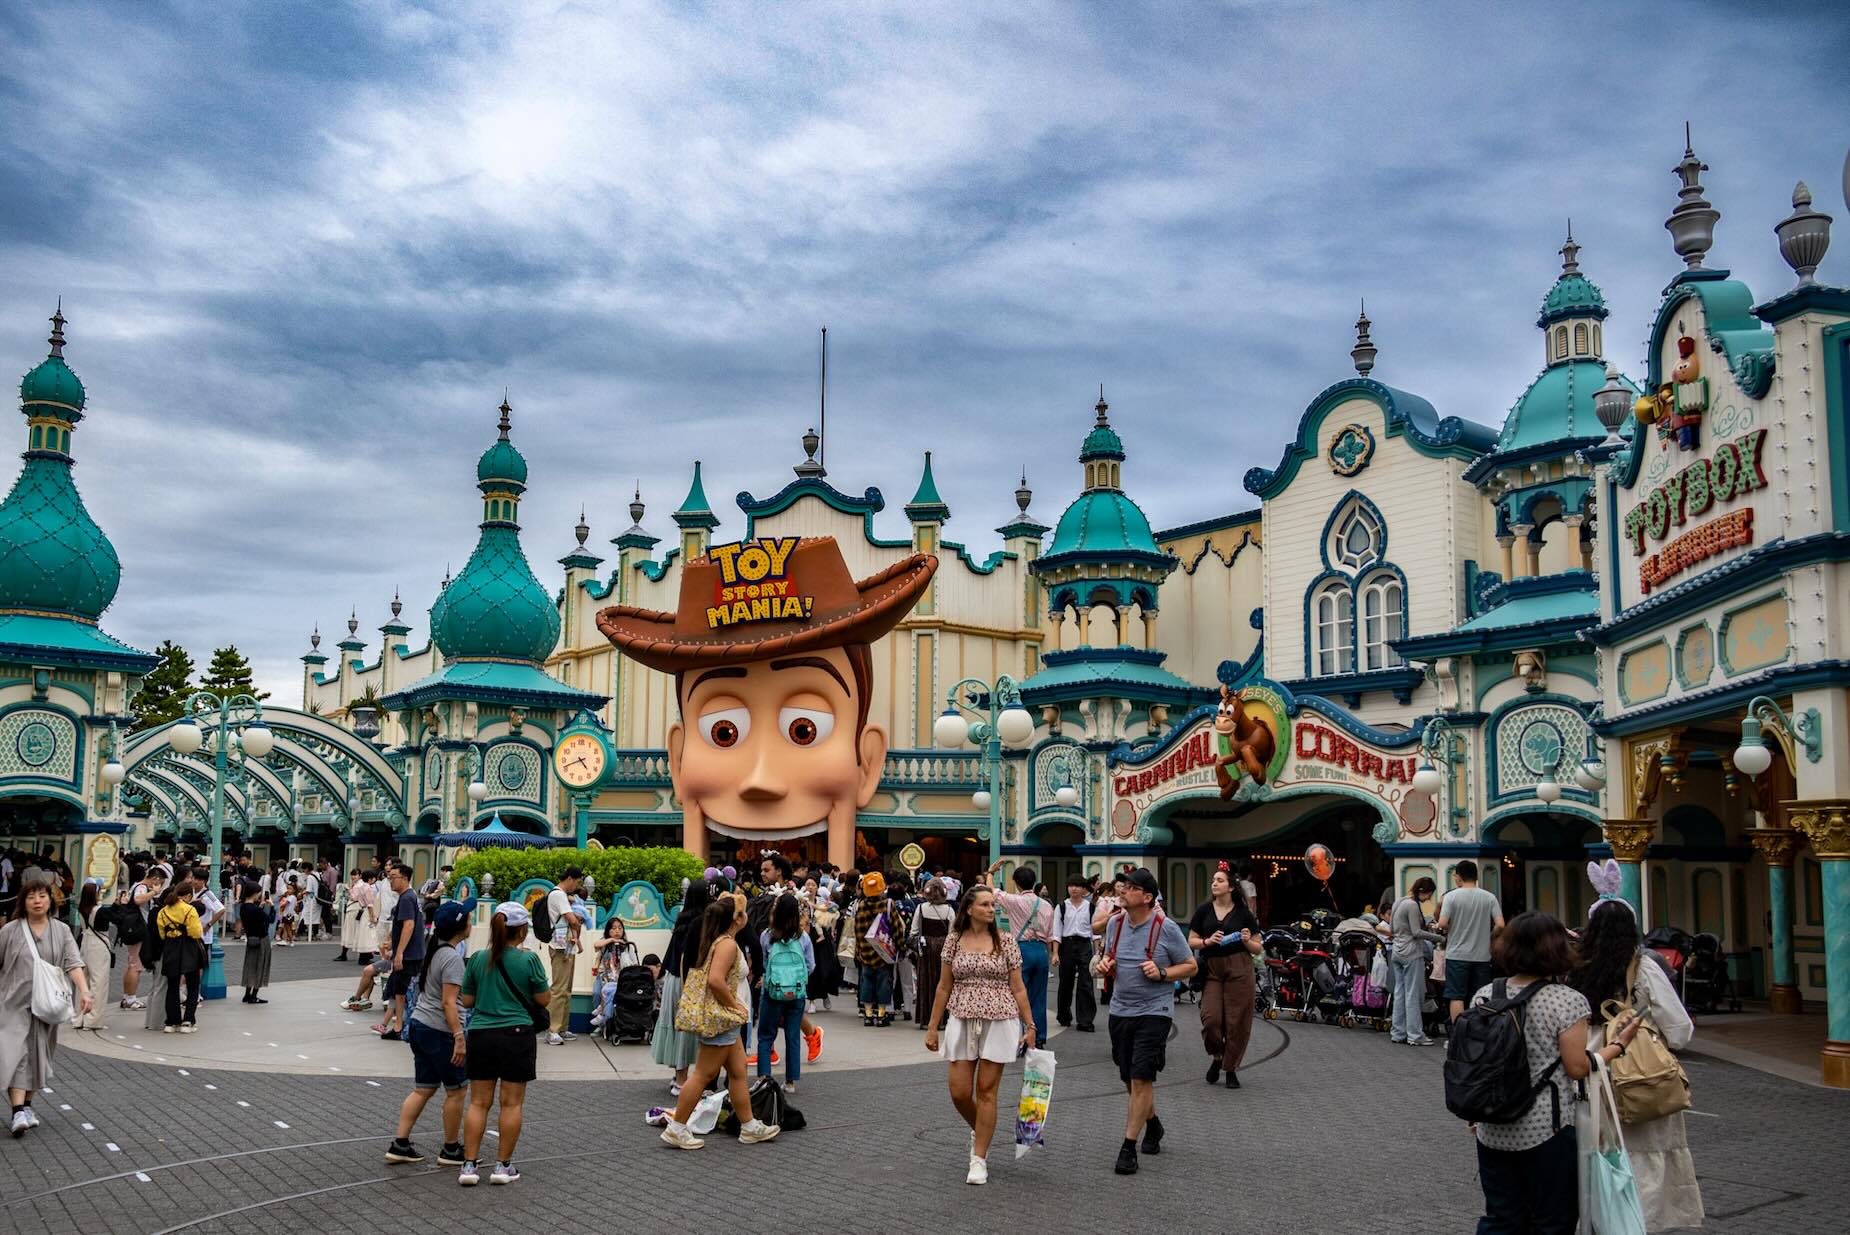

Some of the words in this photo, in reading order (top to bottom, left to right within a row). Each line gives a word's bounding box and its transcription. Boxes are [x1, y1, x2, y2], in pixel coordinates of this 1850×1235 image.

[1625, 429, 1768, 556] TOYBOX
[708, 538, 799, 584] TOY
[722, 581, 789, 602] STORY
[706, 596, 813, 628] MANIA!
[1114, 731, 1218, 797] CARNIVAL
[1175, 769, 1209, 787] RUSTLE
[1295, 764, 1323, 780] SOME
